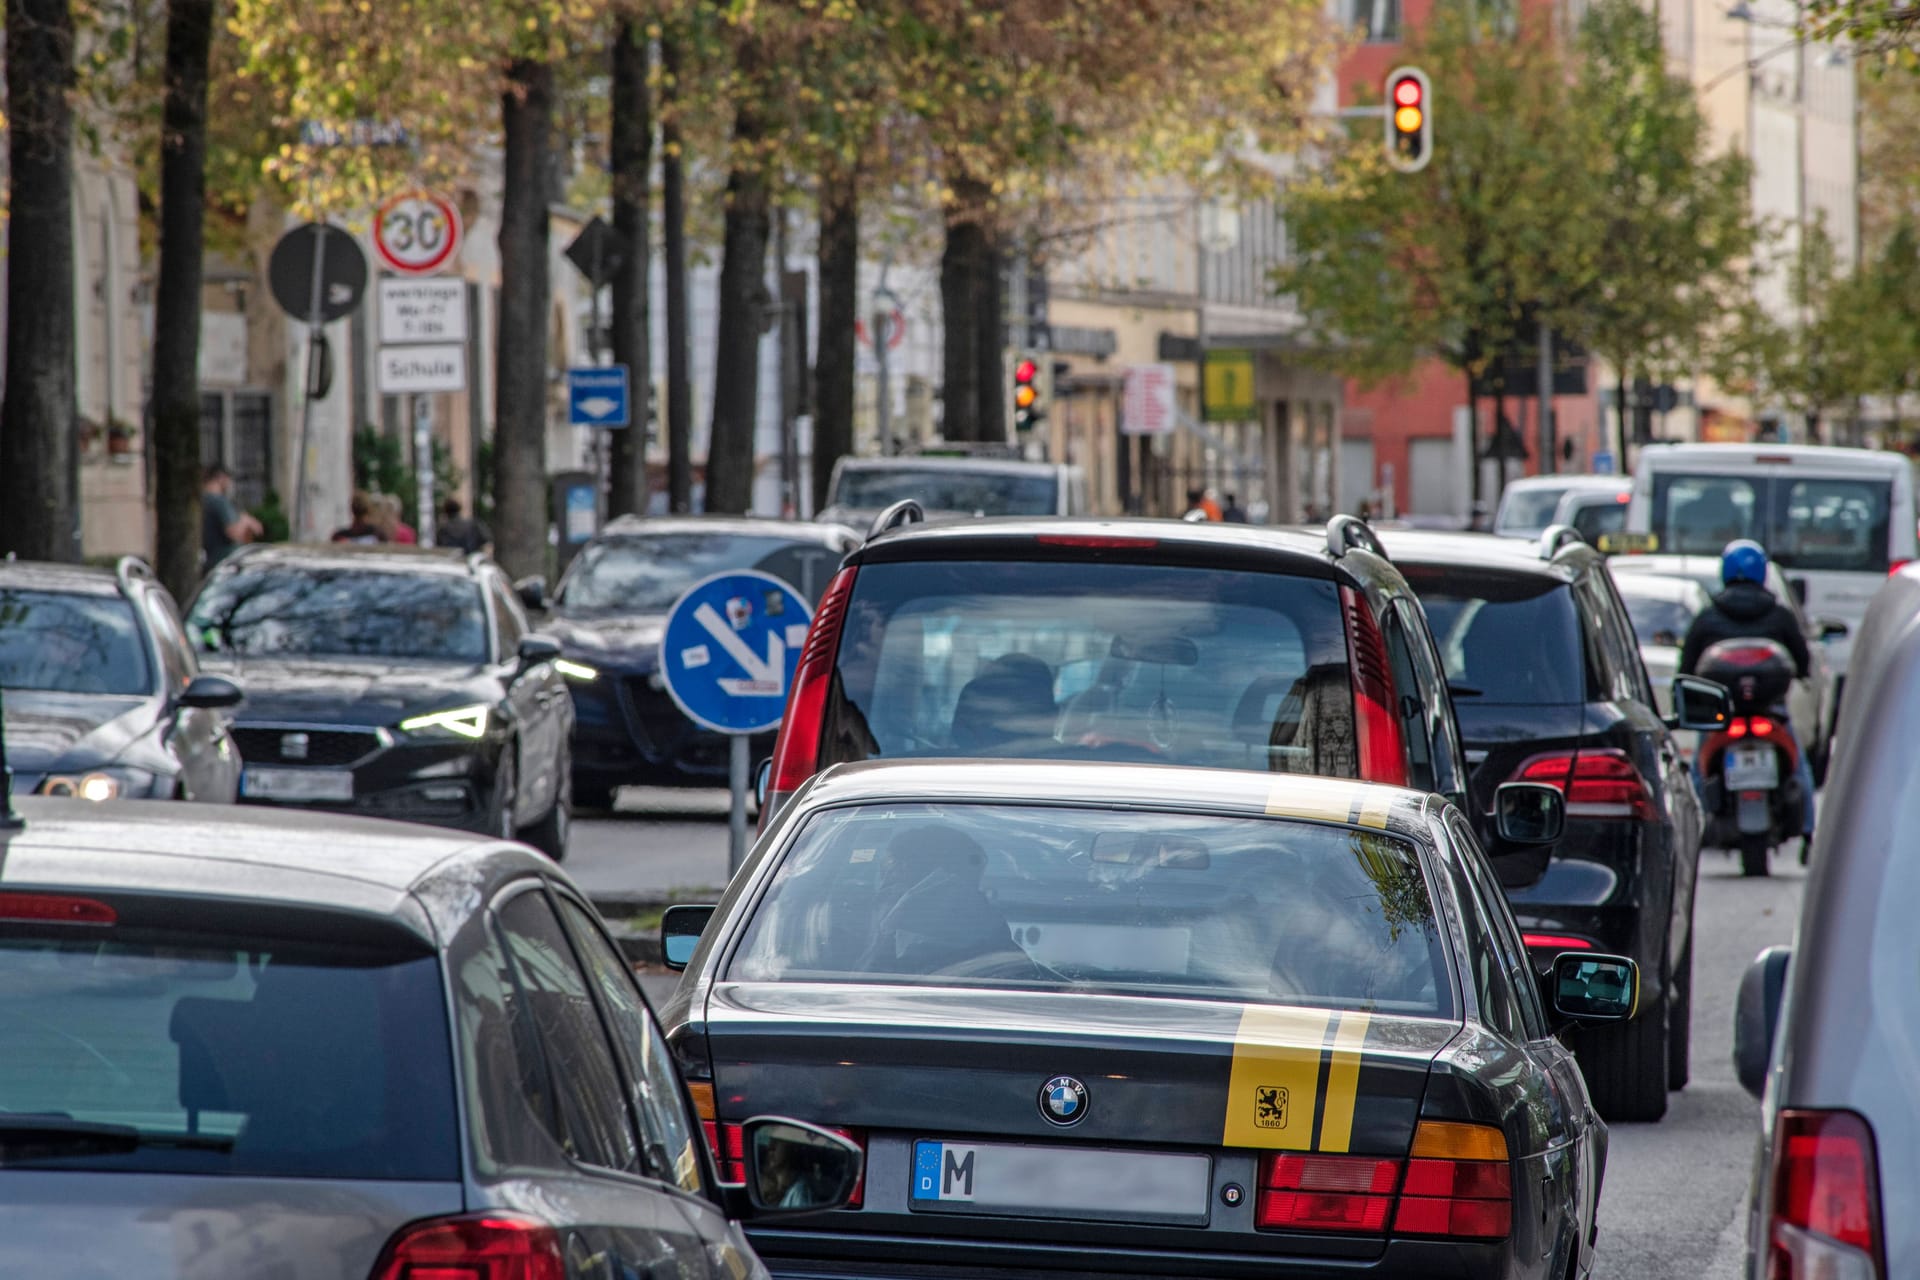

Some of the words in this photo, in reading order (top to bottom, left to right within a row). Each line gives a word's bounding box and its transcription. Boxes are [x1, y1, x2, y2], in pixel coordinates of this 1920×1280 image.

[391, 211, 440, 251] 30
[388, 361, 454, 377] Schule
[1046, 1079, 1084, 1095] BMW
[1262, 1119, 1281, 1127] 1860
[943, 1149, 975, 1195] M
[921, 1176, 932, 1190] D
